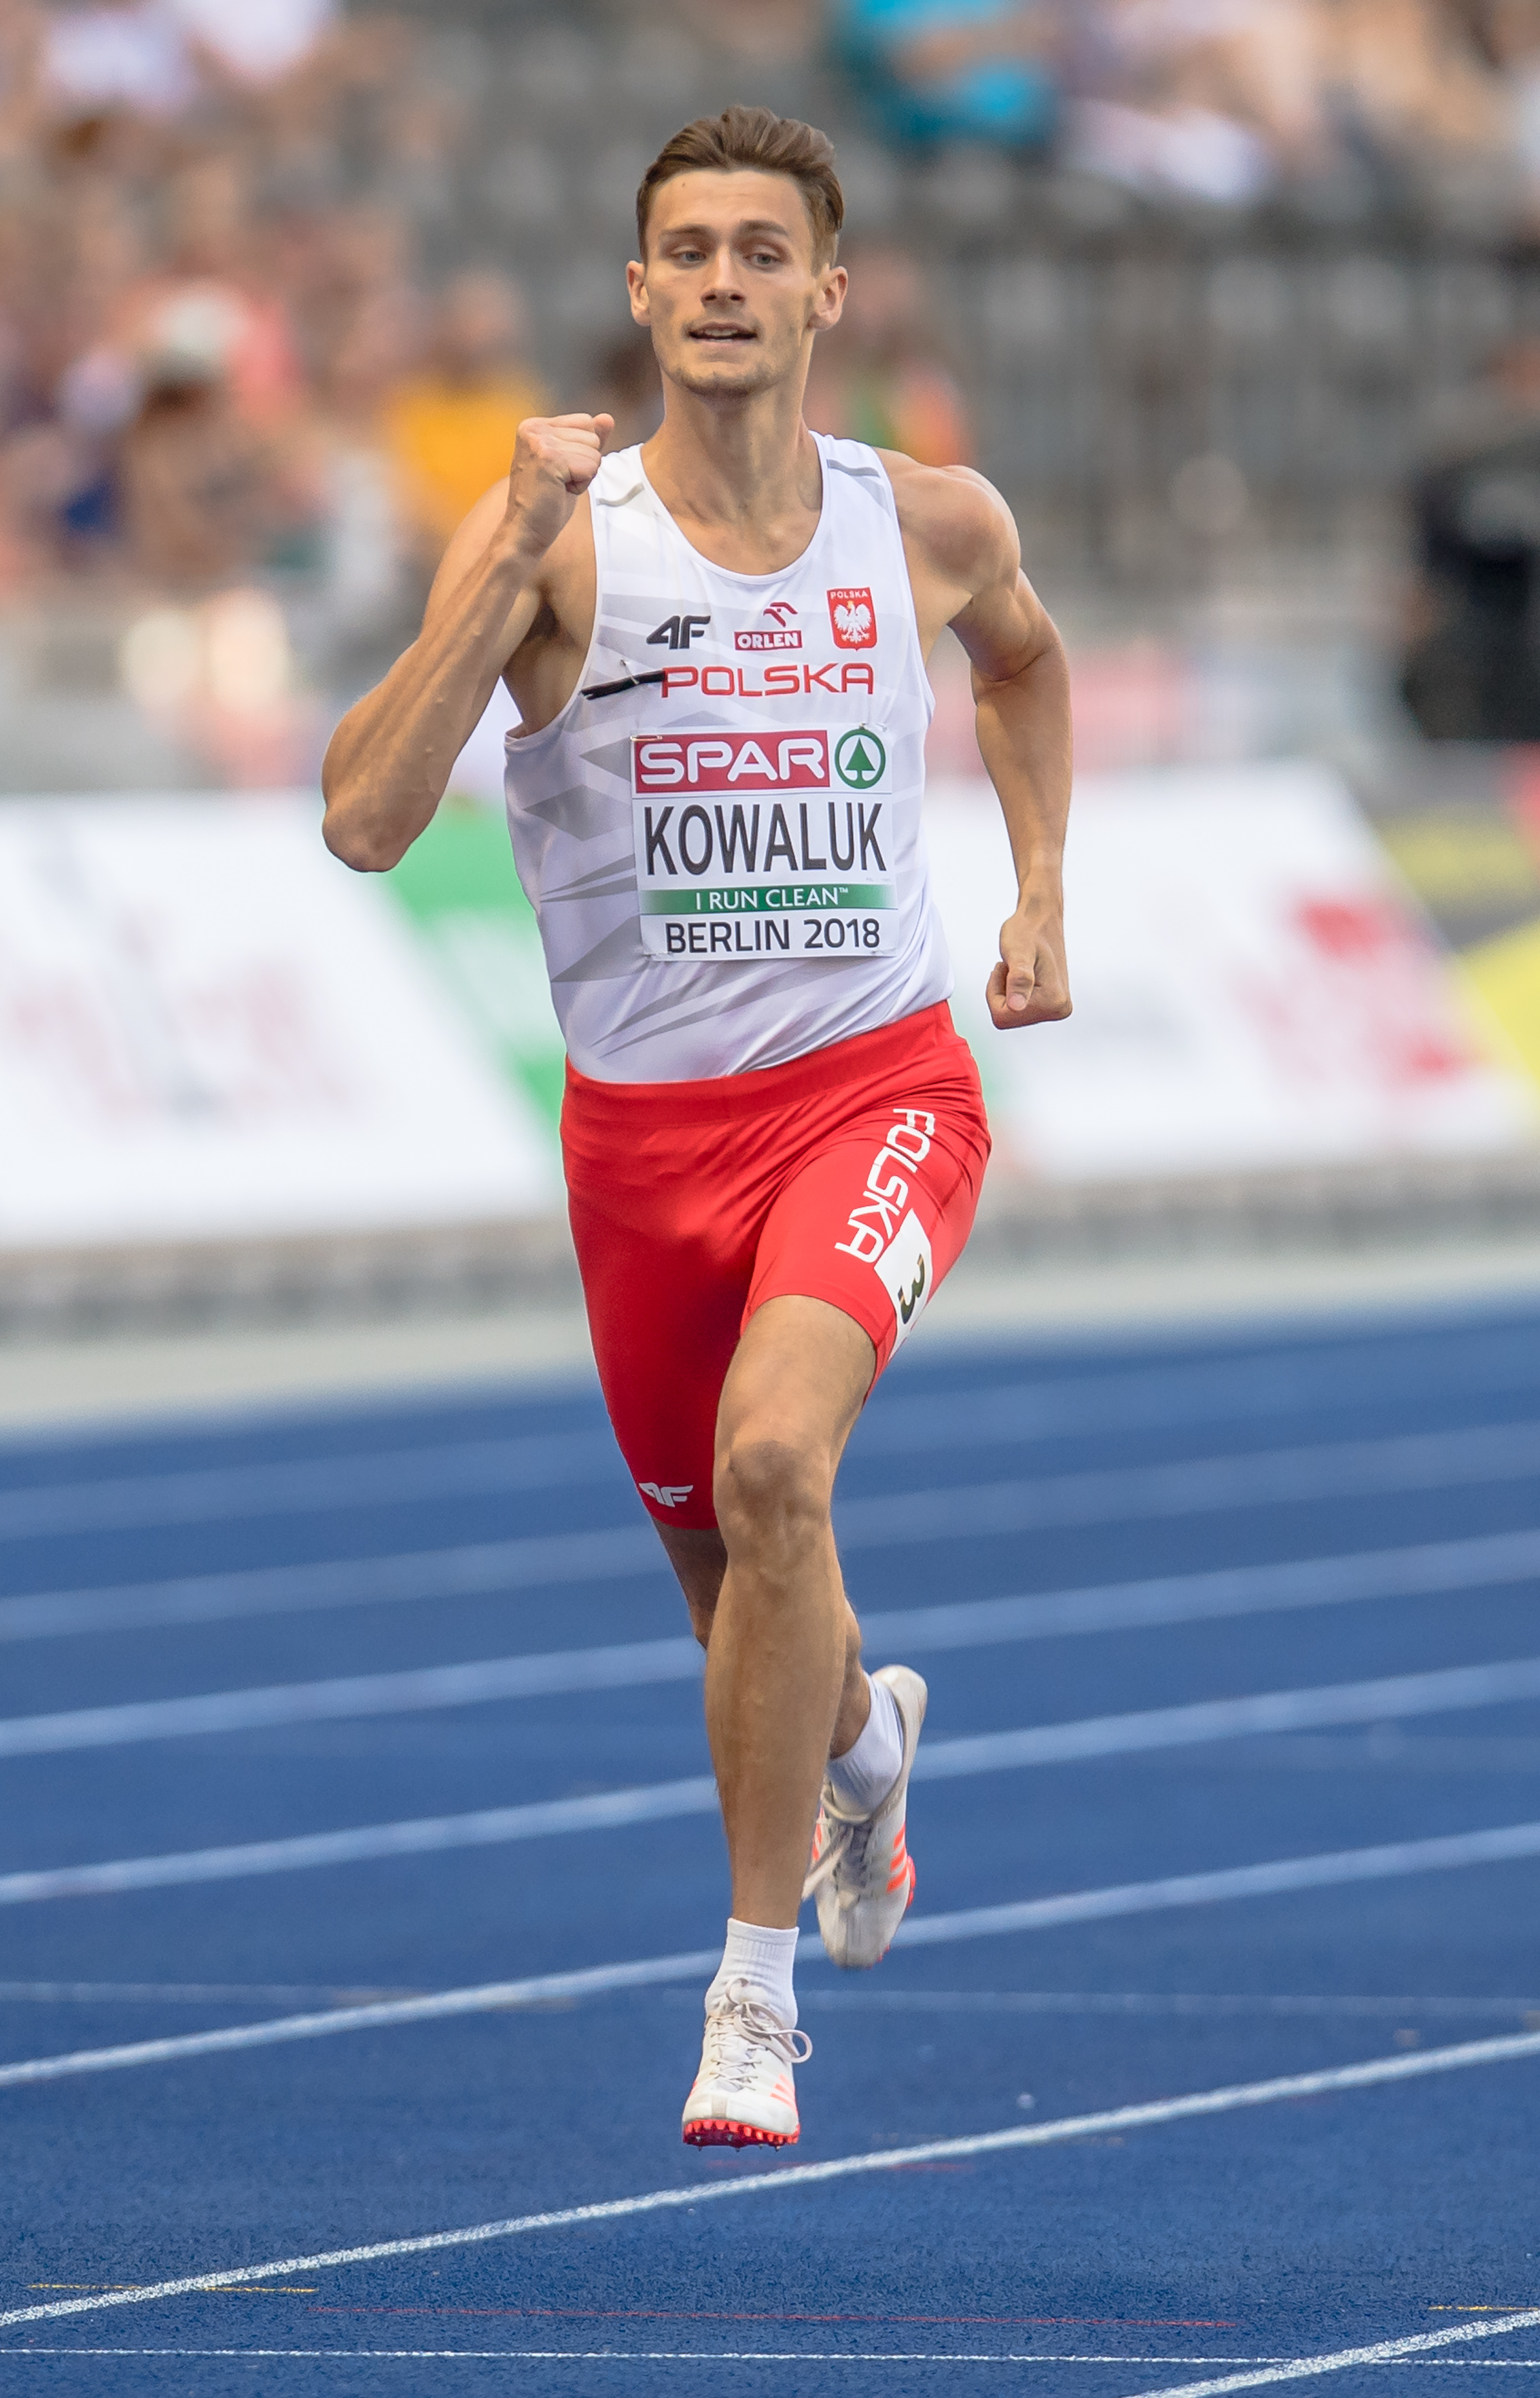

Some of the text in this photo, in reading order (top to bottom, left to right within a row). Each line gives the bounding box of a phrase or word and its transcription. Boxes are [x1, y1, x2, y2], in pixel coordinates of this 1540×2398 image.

[830, 590, 869, 600] POLSKA
[646, 615, 711, 650] 4F
[737, 631, 799, 649] ORLEN
[661, 662, 874, 698] POLSKA
[639, 737, 825, 785] SPAR
[644, 801, 887, 876] KOWALUK
[696, 892, 701, 910] I
[709, 890, 758, 909] RUN
[665, 918, 881, 954] BERLIN 2018
[834, 1108, 936, 1264] POLSKA
[897, 1253, 926, 1325] 3
